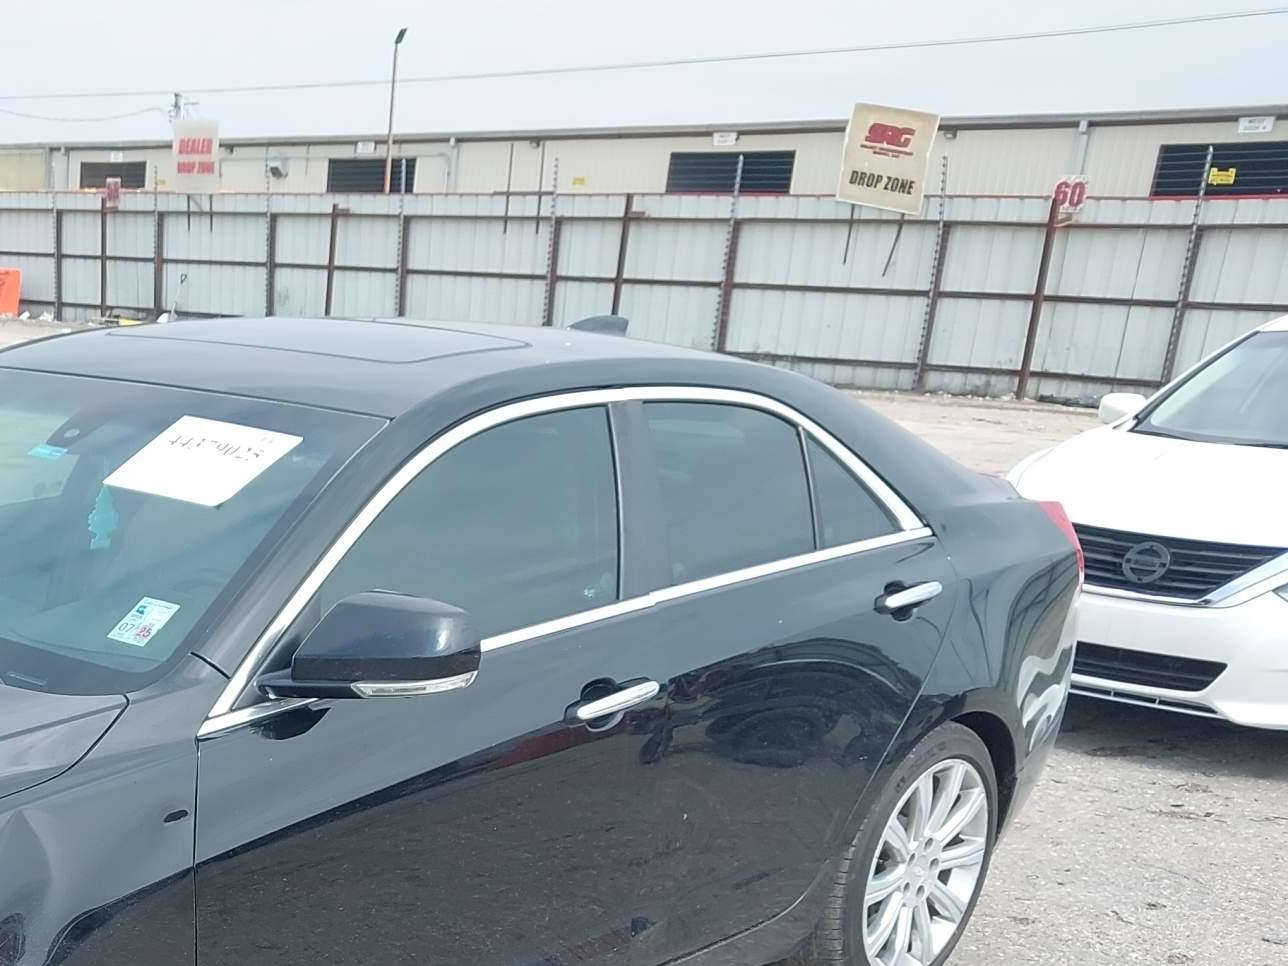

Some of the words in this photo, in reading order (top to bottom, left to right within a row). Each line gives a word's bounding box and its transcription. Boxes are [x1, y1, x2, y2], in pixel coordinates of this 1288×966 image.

[178, 137, 214, 155] DEALER
[848, 170, 883, 189] DROP
[883, 176, 916, 195] ZONE
[1054, 181, 1086, 207] 60
[118, 622, 136, 633] 07
